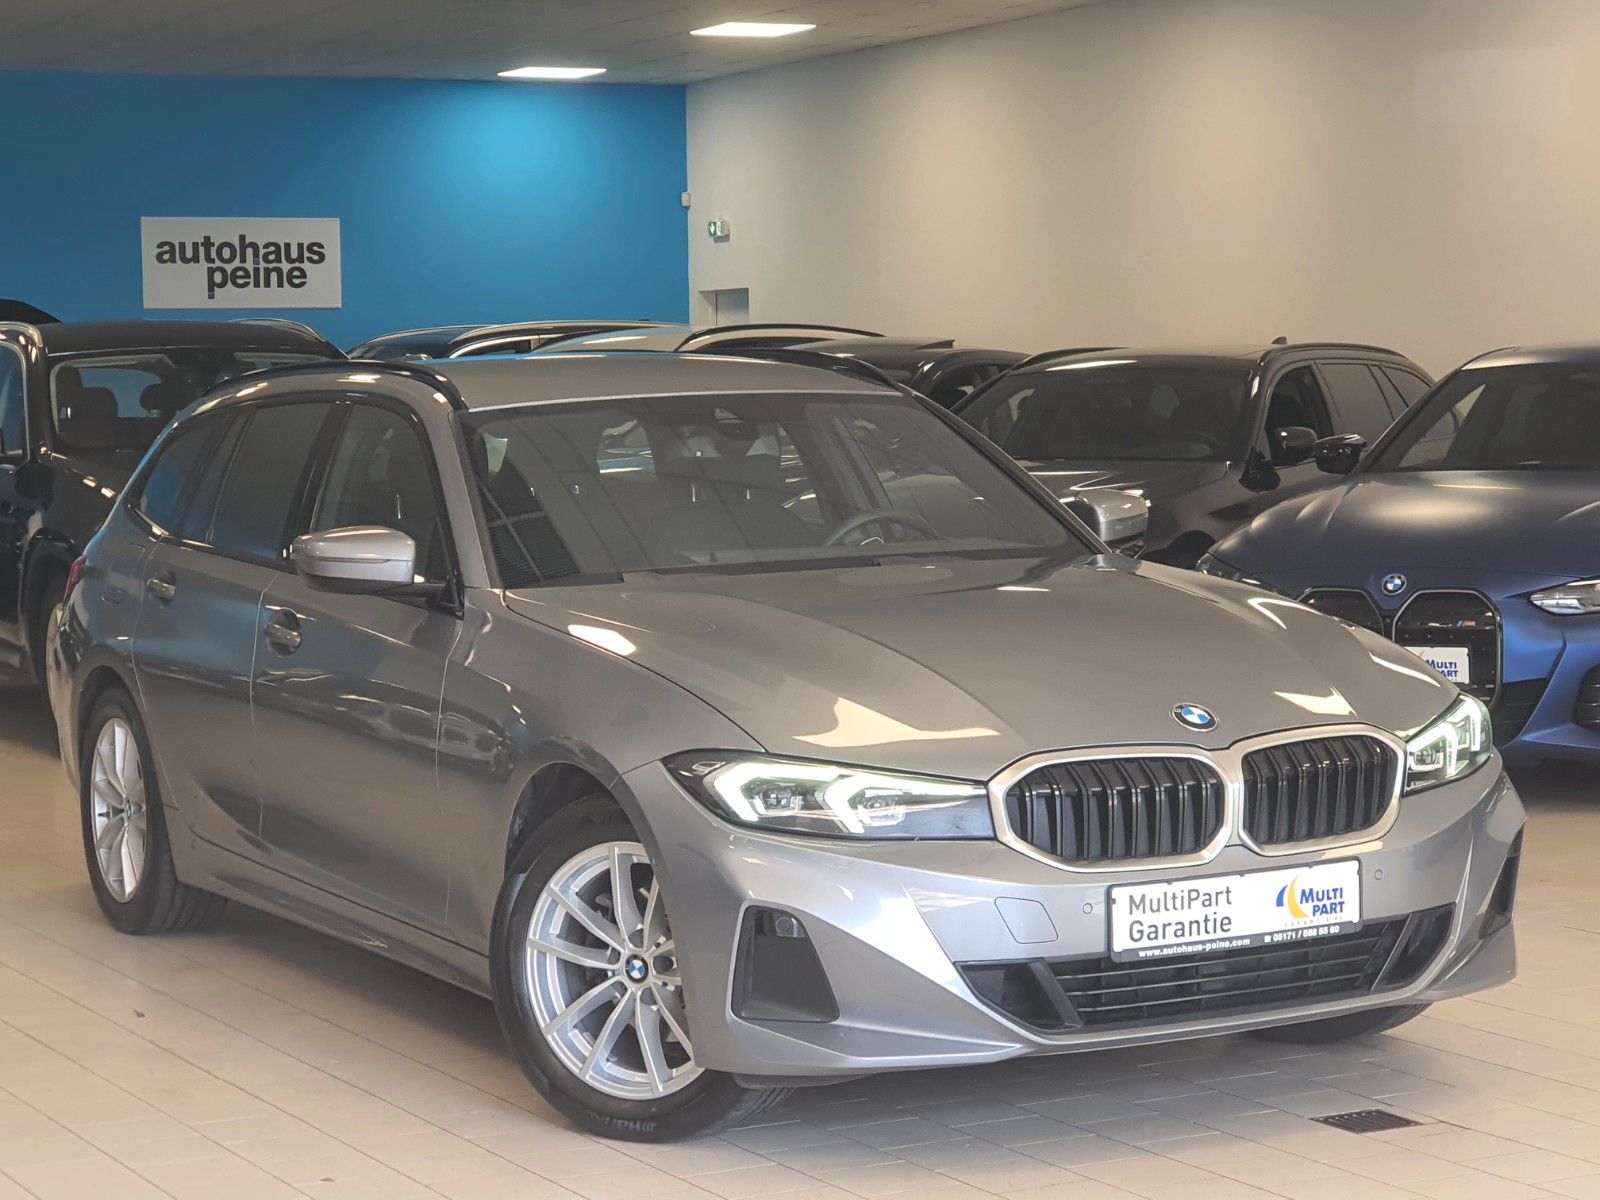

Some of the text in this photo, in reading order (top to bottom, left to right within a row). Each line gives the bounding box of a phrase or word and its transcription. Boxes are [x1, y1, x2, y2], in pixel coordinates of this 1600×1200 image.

[155, 234, 326, 265] autohaus
[207, 266, 307, 299] peine
[1128, 887, 1232, 915] MultiPart
[1300, 888, 1343, 904] MULTI
[1312, 901, 1345, 917] PART
[1129, 913, 1232, 942] Garantie
[1273, 931, 1296, 942] 05171
[1138, 938, 1250, 958] www.autohaus-peine.com
